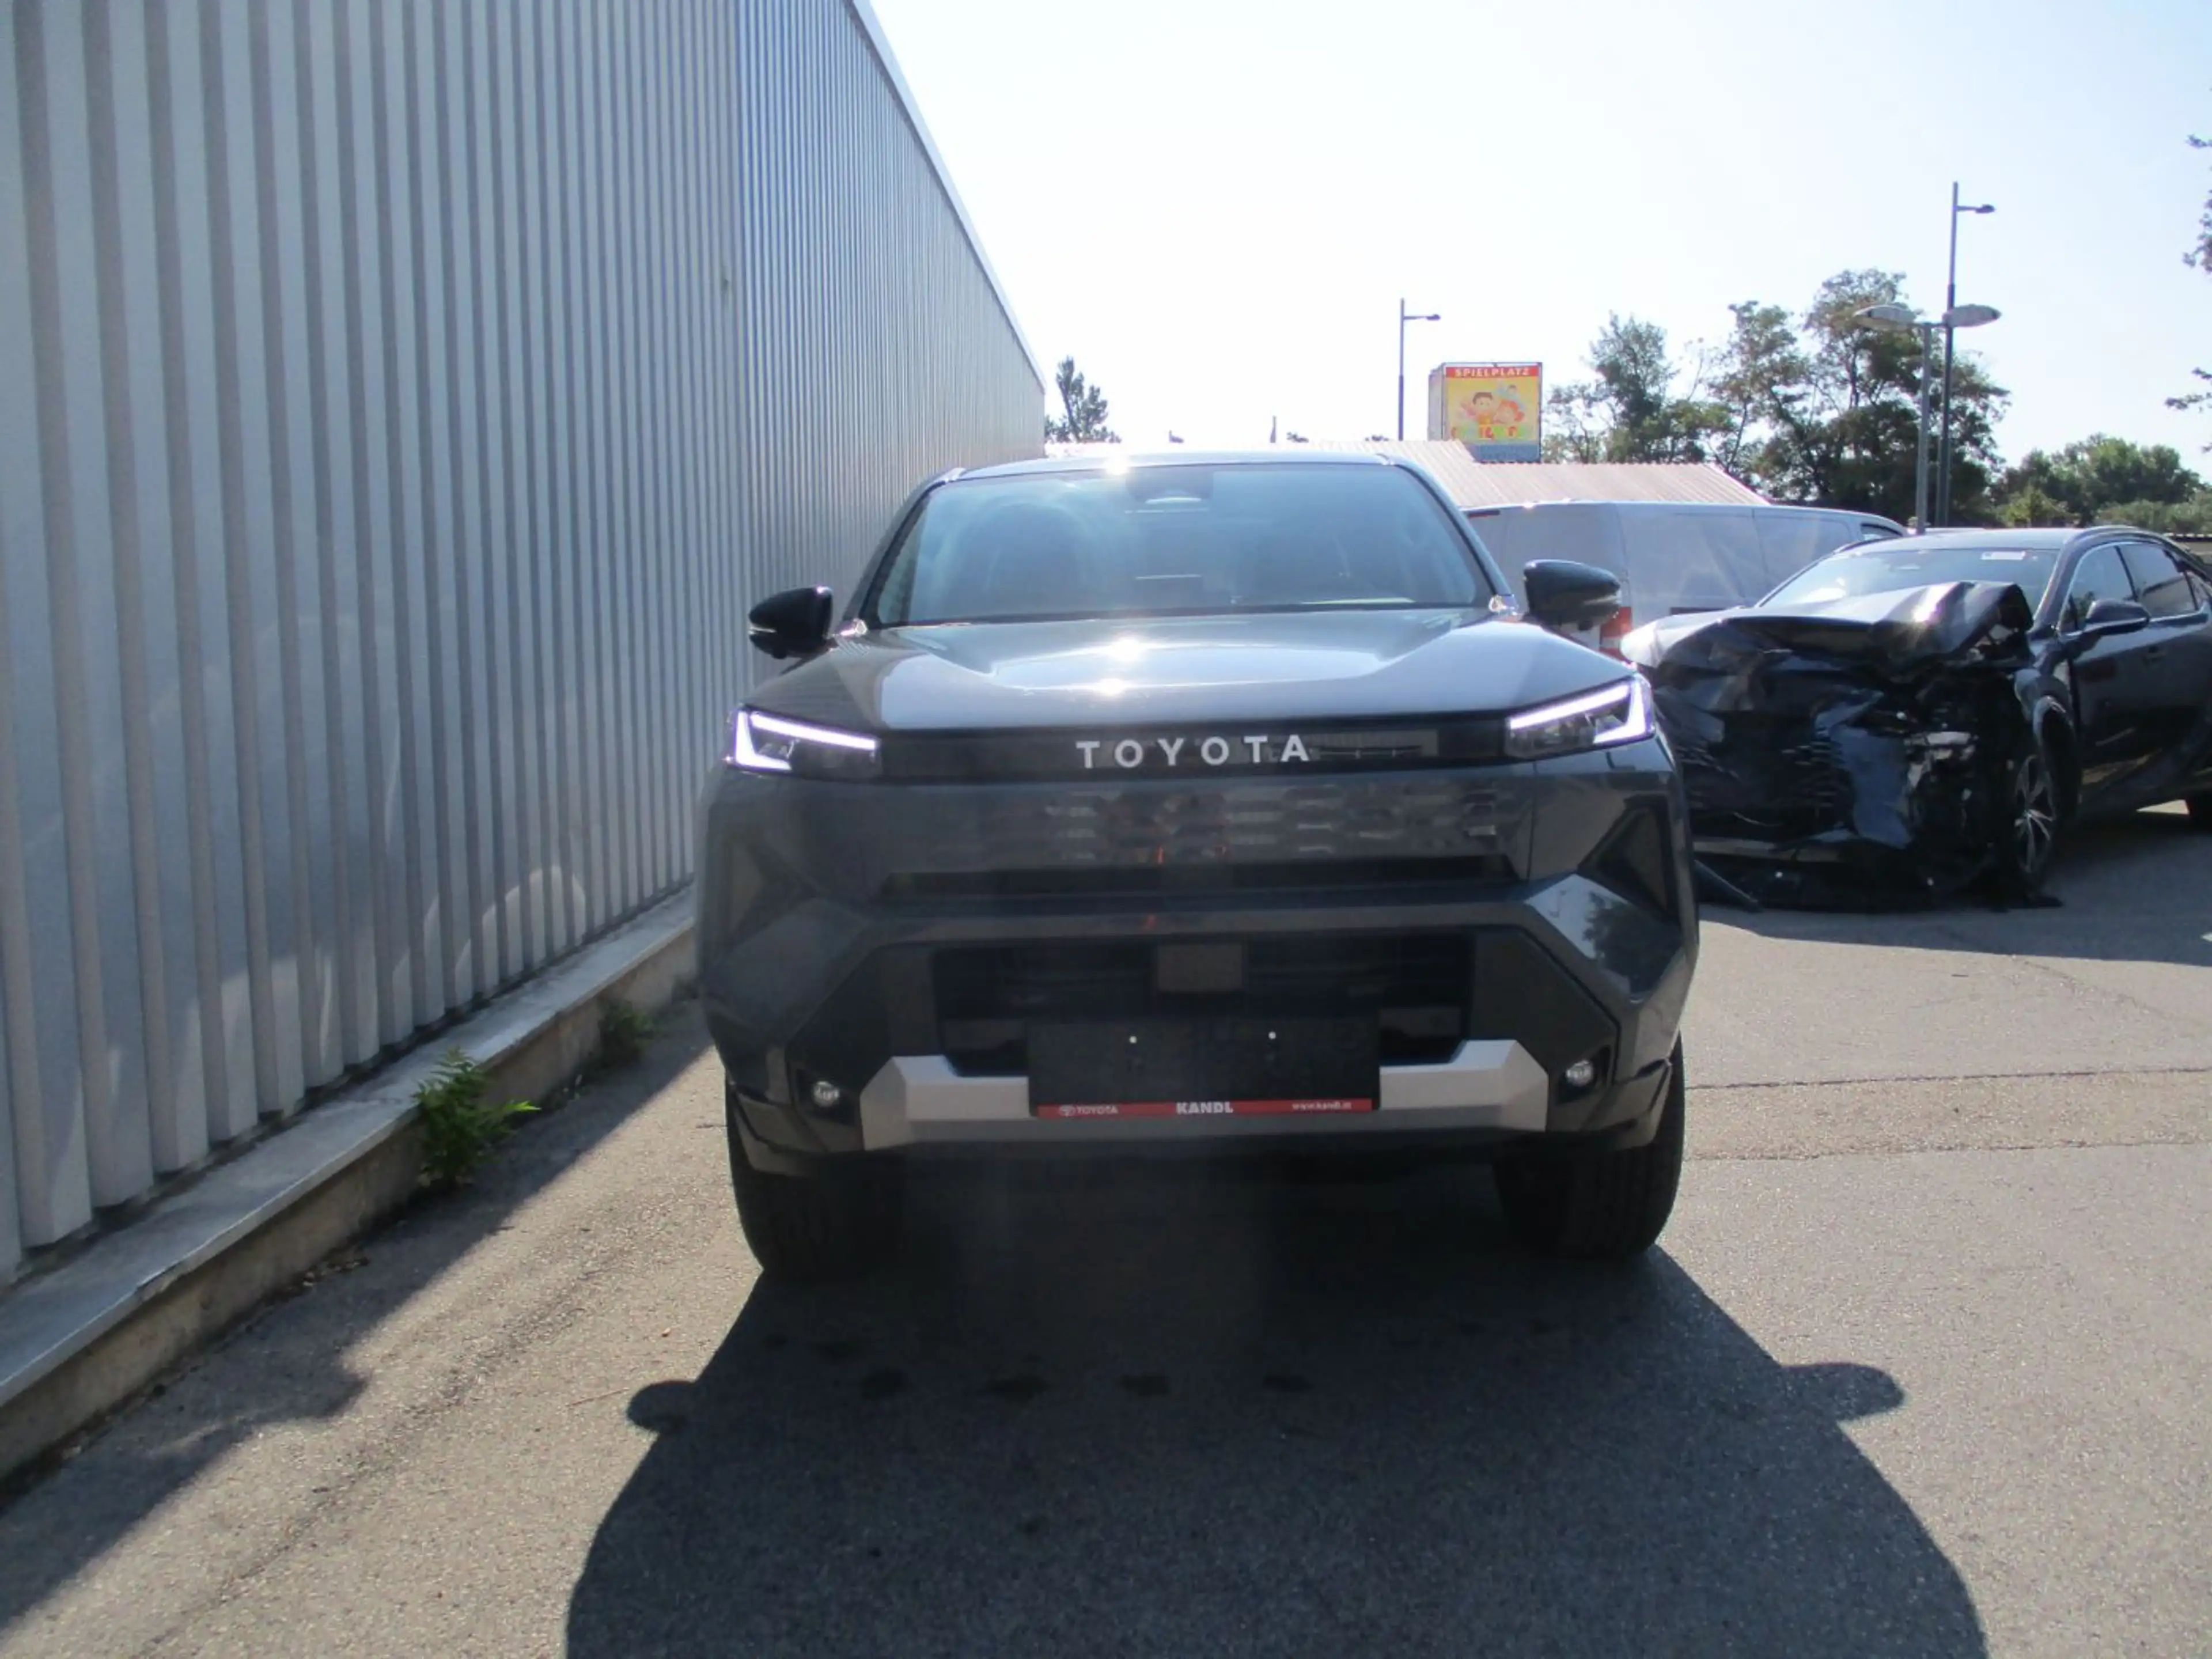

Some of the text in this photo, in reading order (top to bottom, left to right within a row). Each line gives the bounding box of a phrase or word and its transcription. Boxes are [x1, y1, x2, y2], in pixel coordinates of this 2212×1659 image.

[1455, 368, 1529, 377] SPIELPLATZ
[1075, 734, 1309, 769] TOYOTA
[1075, 1105, 1118, 1115] TOYOTA
[1176, 1101, 1233, 1114] KANDL
